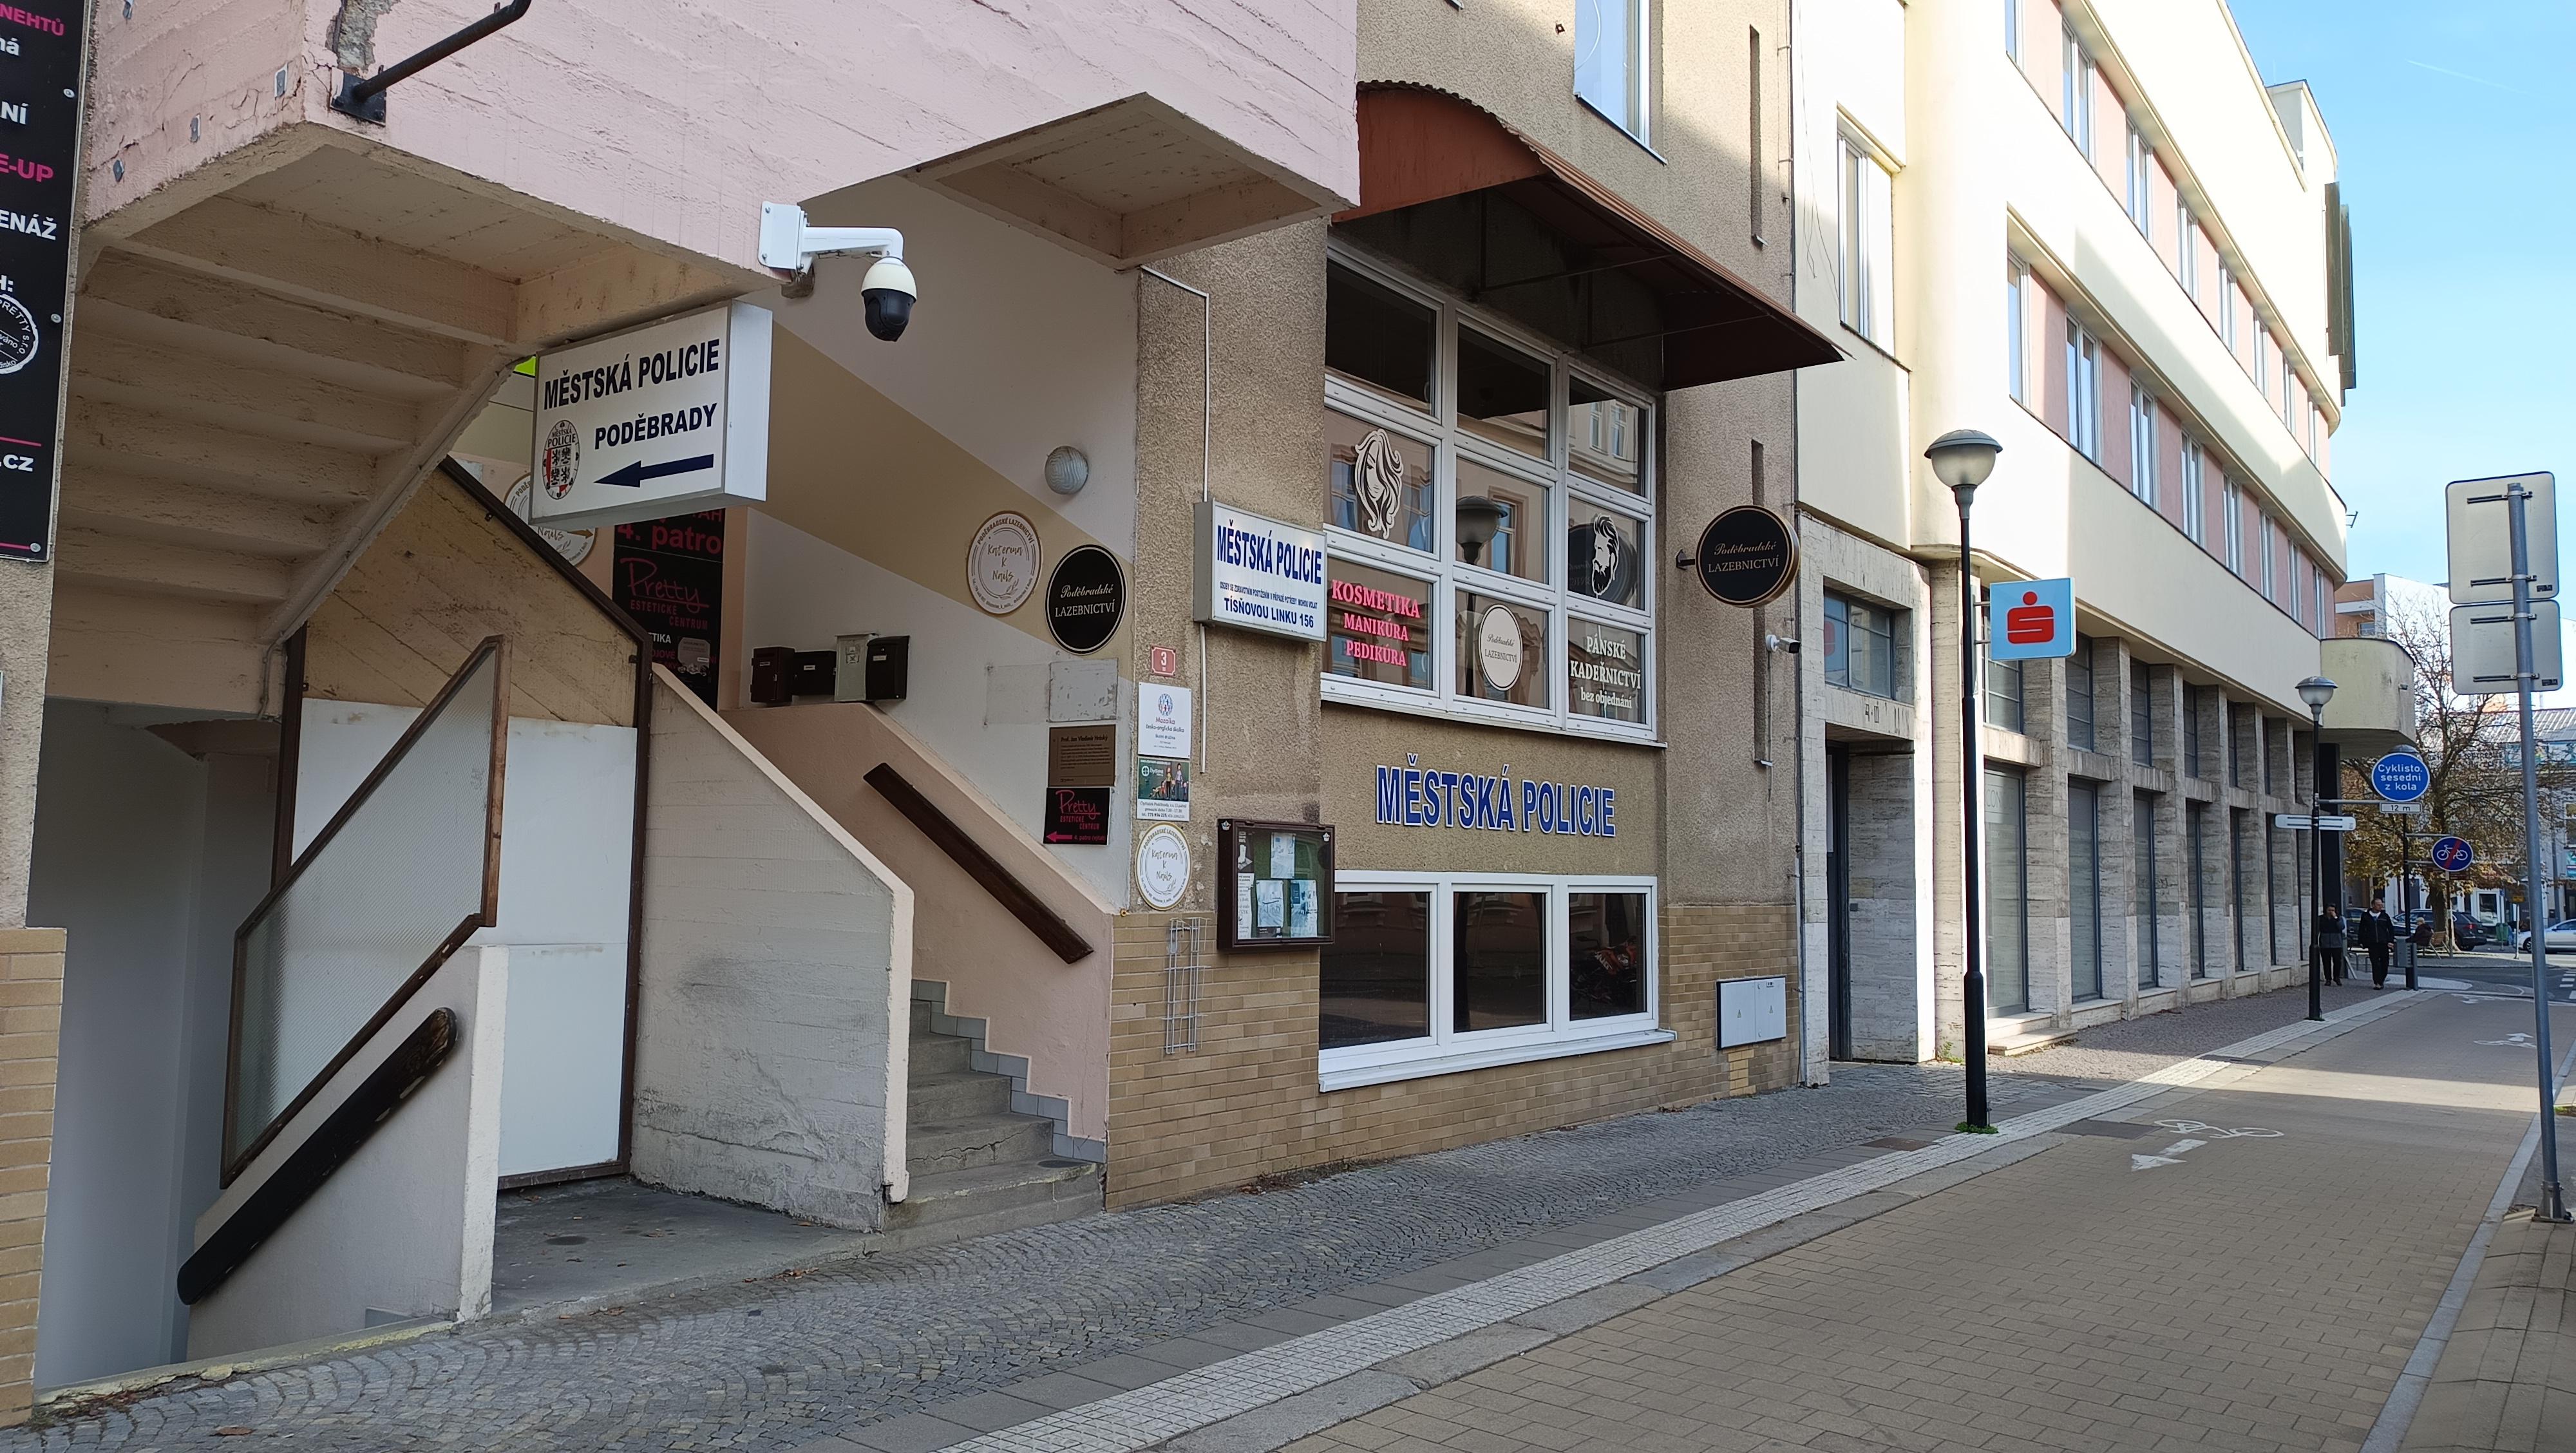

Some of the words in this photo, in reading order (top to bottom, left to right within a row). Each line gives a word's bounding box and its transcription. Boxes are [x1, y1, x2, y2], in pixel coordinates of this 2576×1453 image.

[544, 354, 632, 410] MĚSTSKÁ
[638, 339, 720, 388] POLICIE
[595, 403, 717, 450] PODĚBRADY
[547, 433, 576, 448] POLICIE
[652, 525, 722, 555] patro
[1217, 518, 1273, 574] MĚSTSKÁ
[1276, 540, 1321, 585] POLICIE
[1714, 541, 1777, 555] Poděbradské
[992, 569, 1014, 583] Nails
[1709, 555, 1779, 573] LAZEBNICTVÍ
[620, 557, 702, 614] Pretty
[1061, 584, 1113, 598] Poděbradské
[1332, 579, 1420, 618] KOSMETIKA
[1055, 598, 1115, 617] LAZEBNICTVÍ
[1224, 596, 1269, 619] TÍSŇOVOU
[1271, 607, 1297, 625] LINKU
[1300, 613, 1314, 628] 156
[670, 616, 708, 630] CENTRUM
[1344, 613, 1409, 641] MANIKÚRA
[649, 632, 671, 643] TIKA
[1586, 633, 1626, 660] PÁNSKÉ
[1160, 651, 1167, 666] 3
[1346, 639, 1406, 666] PEDIKÚRA
[1484, 649, 1517, 663] LAZEBNICTVÍ
[1570, 660, 1641, 689] KADEŘNICTVÍ
[1580, 687, 1595, 702] bez
[1595, 690, 1633, 709] objednání
[2380, 773, 2421, 781] sesedni
[1056, 790, 1097, 820] Pretty
[1376, 752, 1516, 831] MĚSTSKÁ
[1522, 779, 1616, 837] POLICIE
